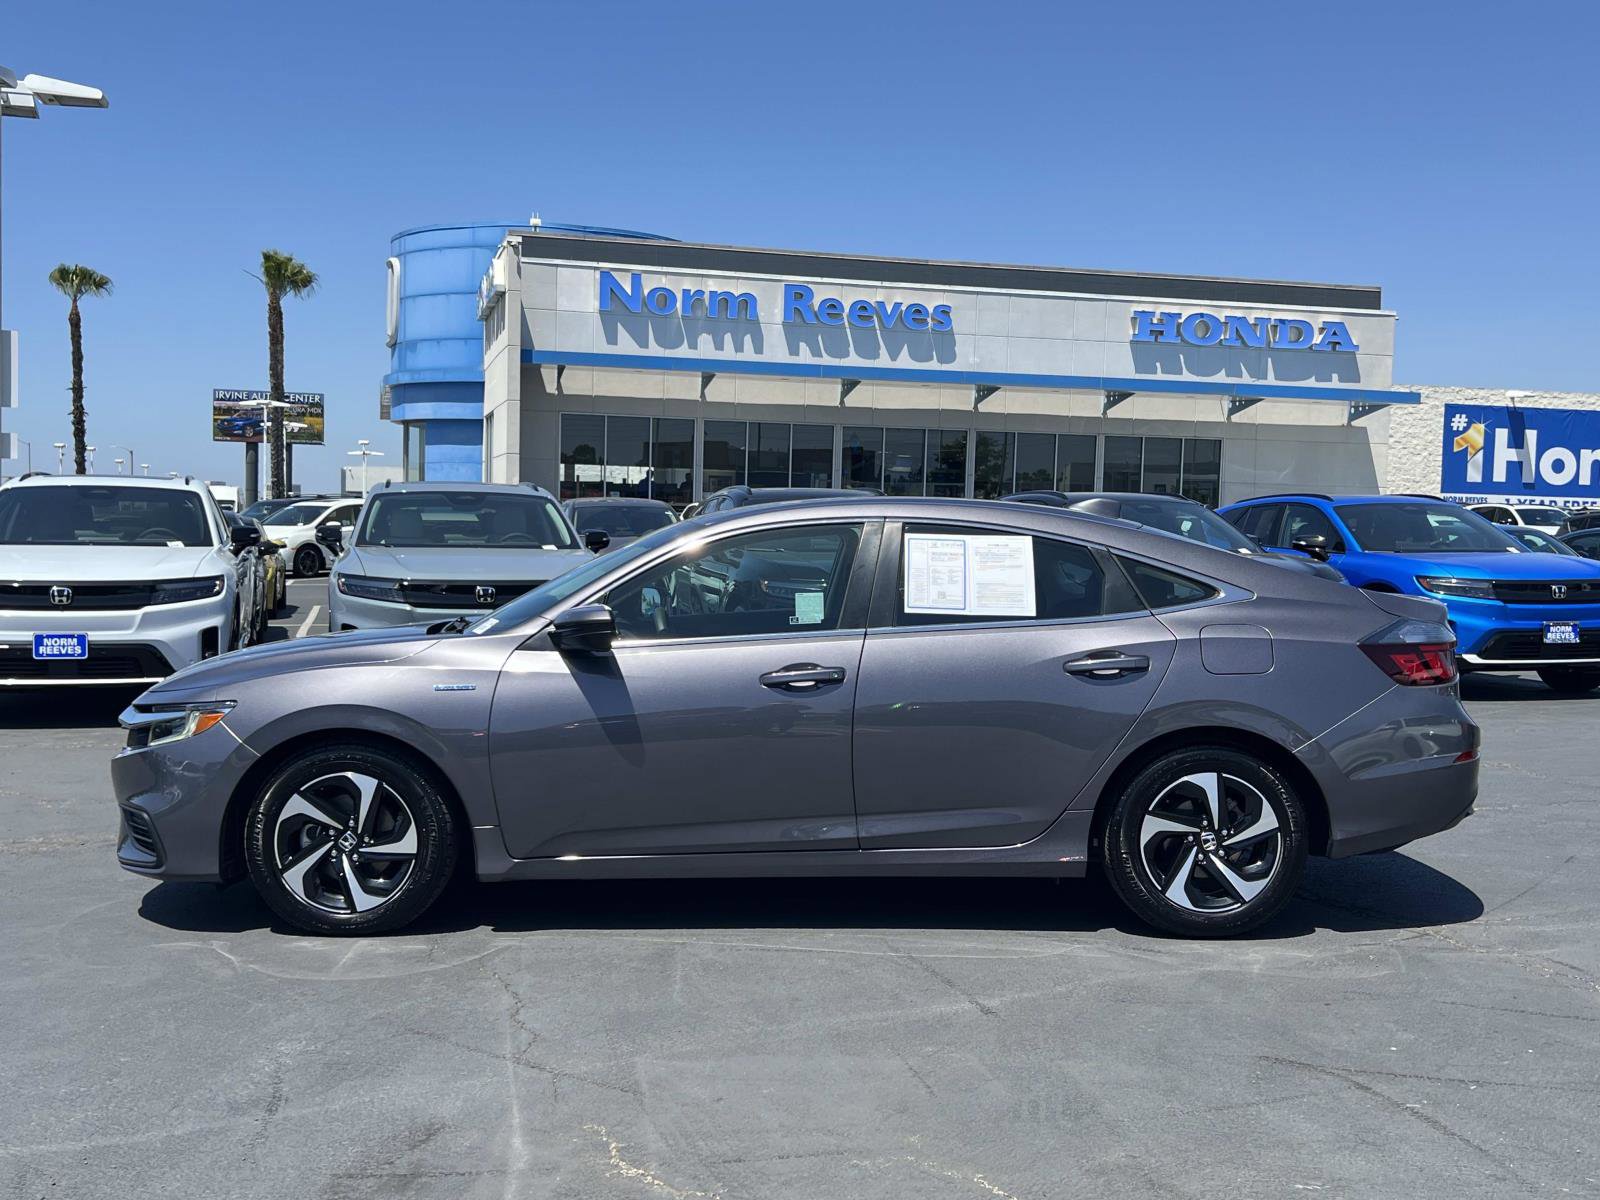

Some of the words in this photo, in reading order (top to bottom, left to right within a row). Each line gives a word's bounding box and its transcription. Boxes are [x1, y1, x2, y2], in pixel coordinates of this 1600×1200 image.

[600, 270, 758, 321] Norm
[783, 283, 954, 332] Reeves
[1132, 310, 1360, 352] HONDA
[215, 390, 249, 400] IRVINE
[251, 392, 271, 401] AUT
[43, 637, 78, 646] NORM
[39, 646, 82, 655] REEVES
